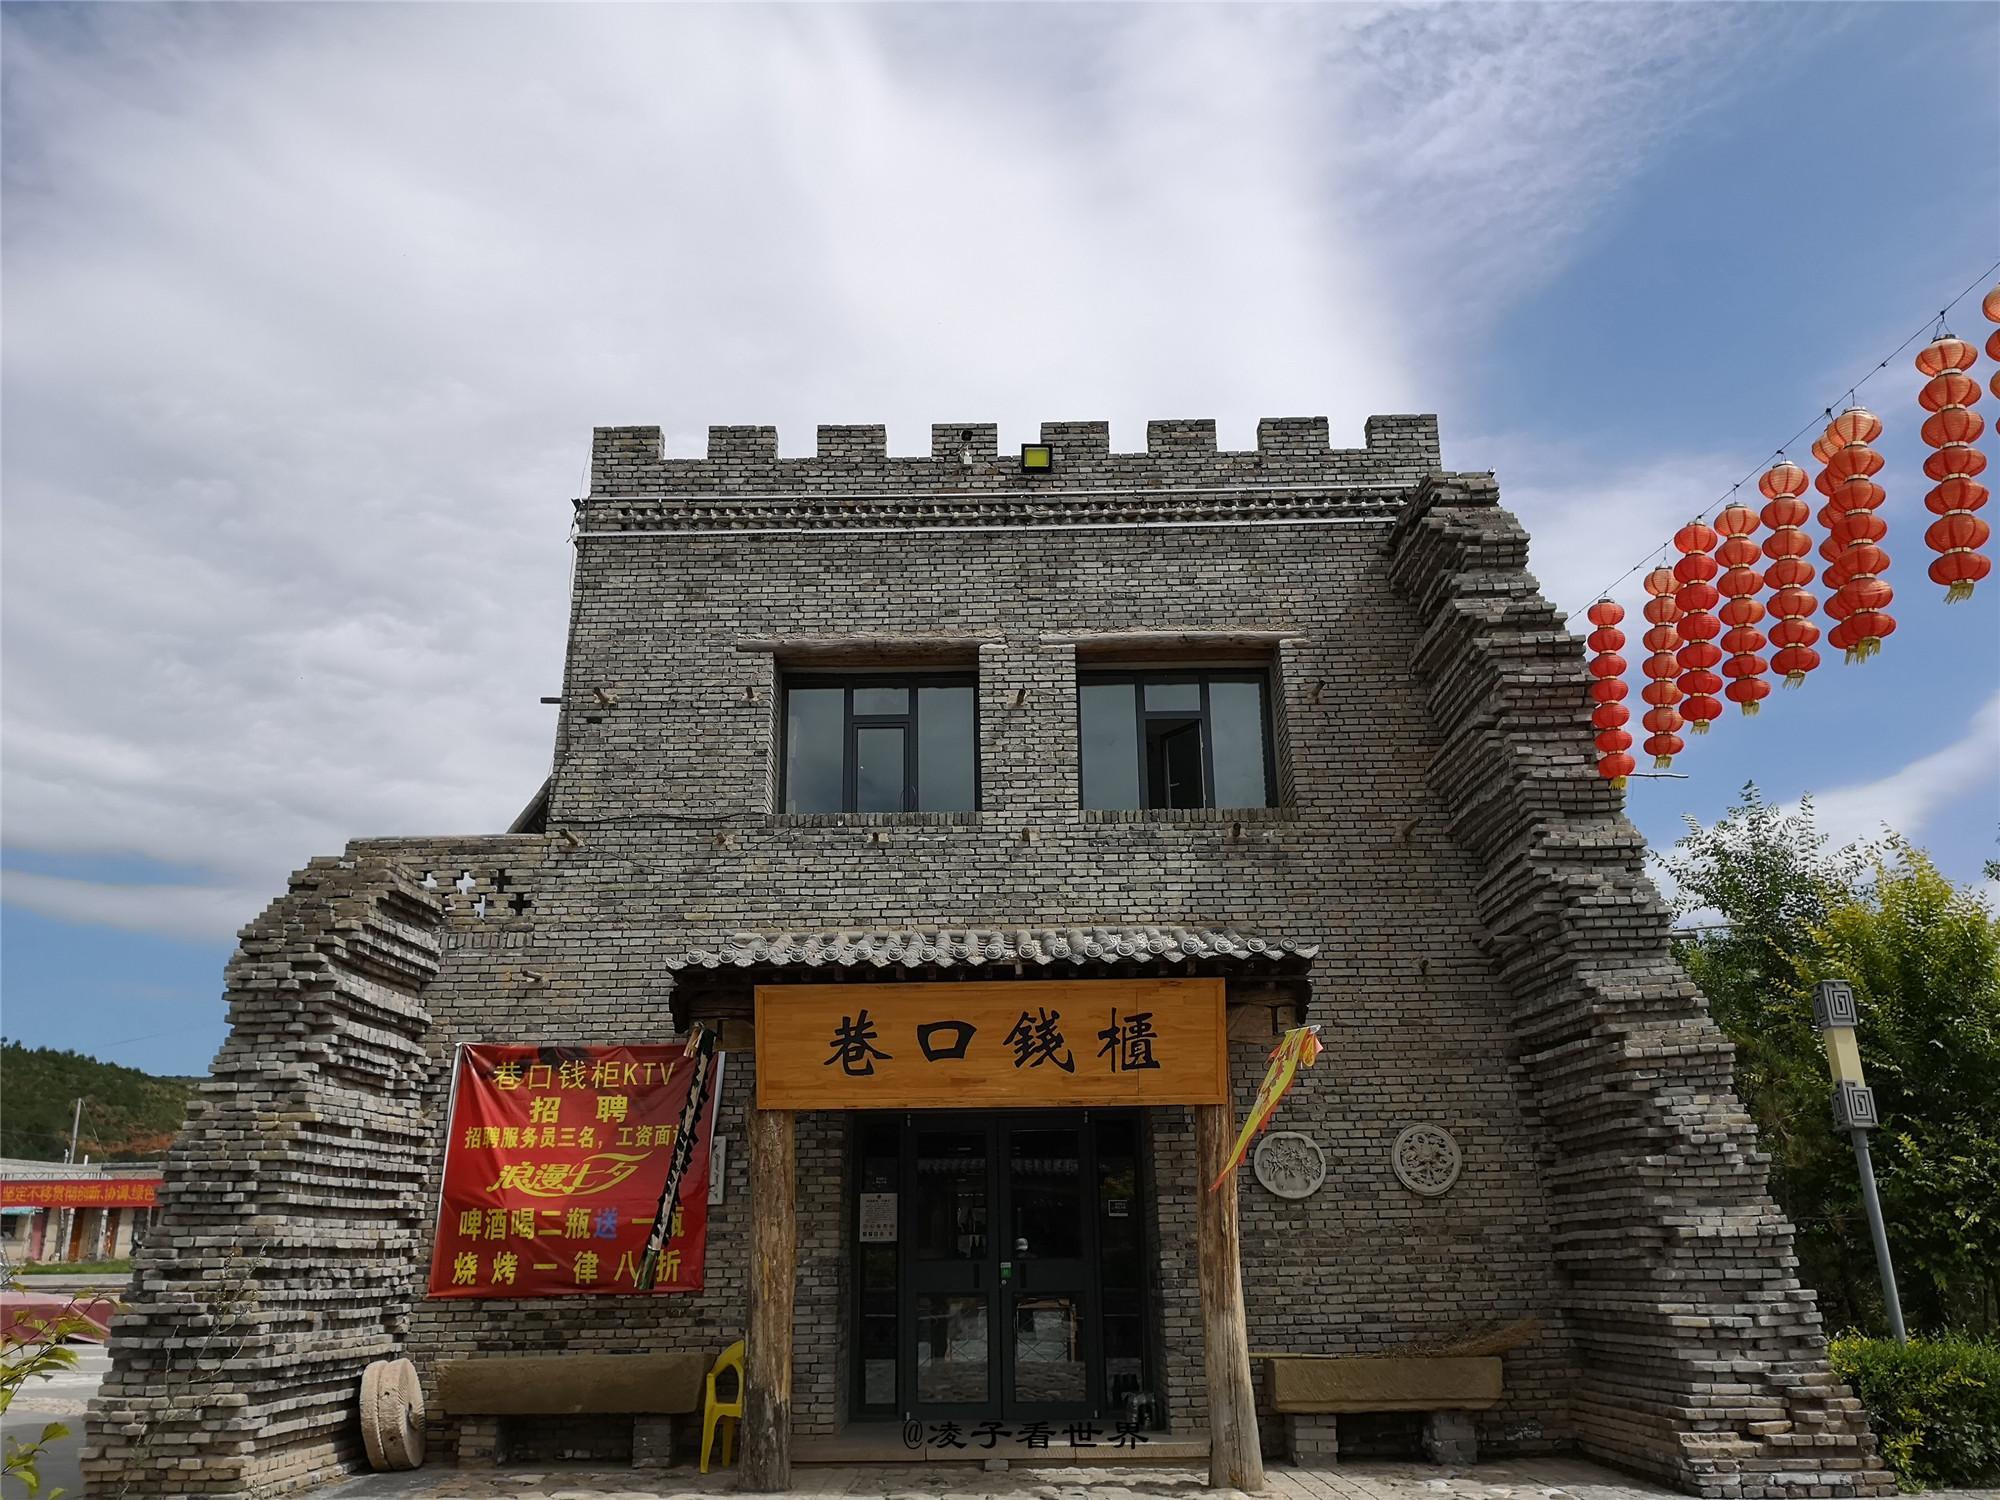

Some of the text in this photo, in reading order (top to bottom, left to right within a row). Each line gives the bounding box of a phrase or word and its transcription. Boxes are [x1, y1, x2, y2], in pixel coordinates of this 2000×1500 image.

[823, 1006, 1161, 1077] 巷口錢櫃
[492, 1059, 676, 1091] 巷口钱柜KTV
[529, 1094, 628, 1124] 招聘
[486, 1151, 653, 1197] 浪漫七夕
[452, 1249, 682, 1286] 烧烤一律八折
